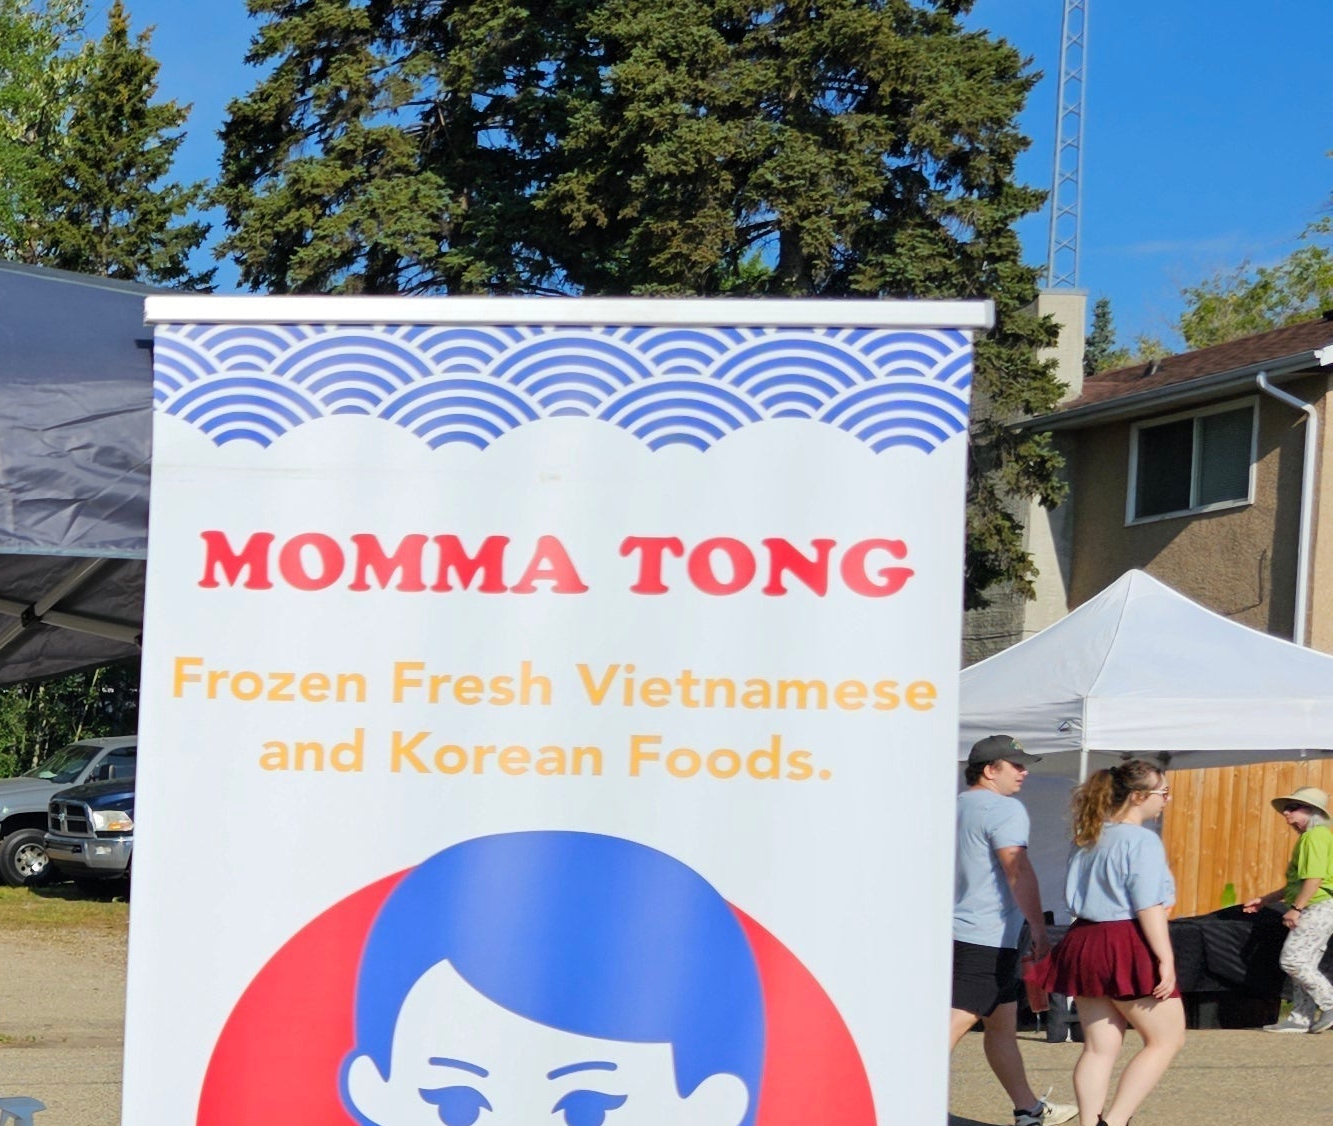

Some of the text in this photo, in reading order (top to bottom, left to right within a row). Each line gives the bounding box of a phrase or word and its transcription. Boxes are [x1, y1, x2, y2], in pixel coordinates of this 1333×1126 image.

[198, 530, 915, 598] MOMMA TONG
[172, 656, 938, 711] Frozen Fresh Vietnamese
[259, 727, 834, 781] and Korean Foods.
